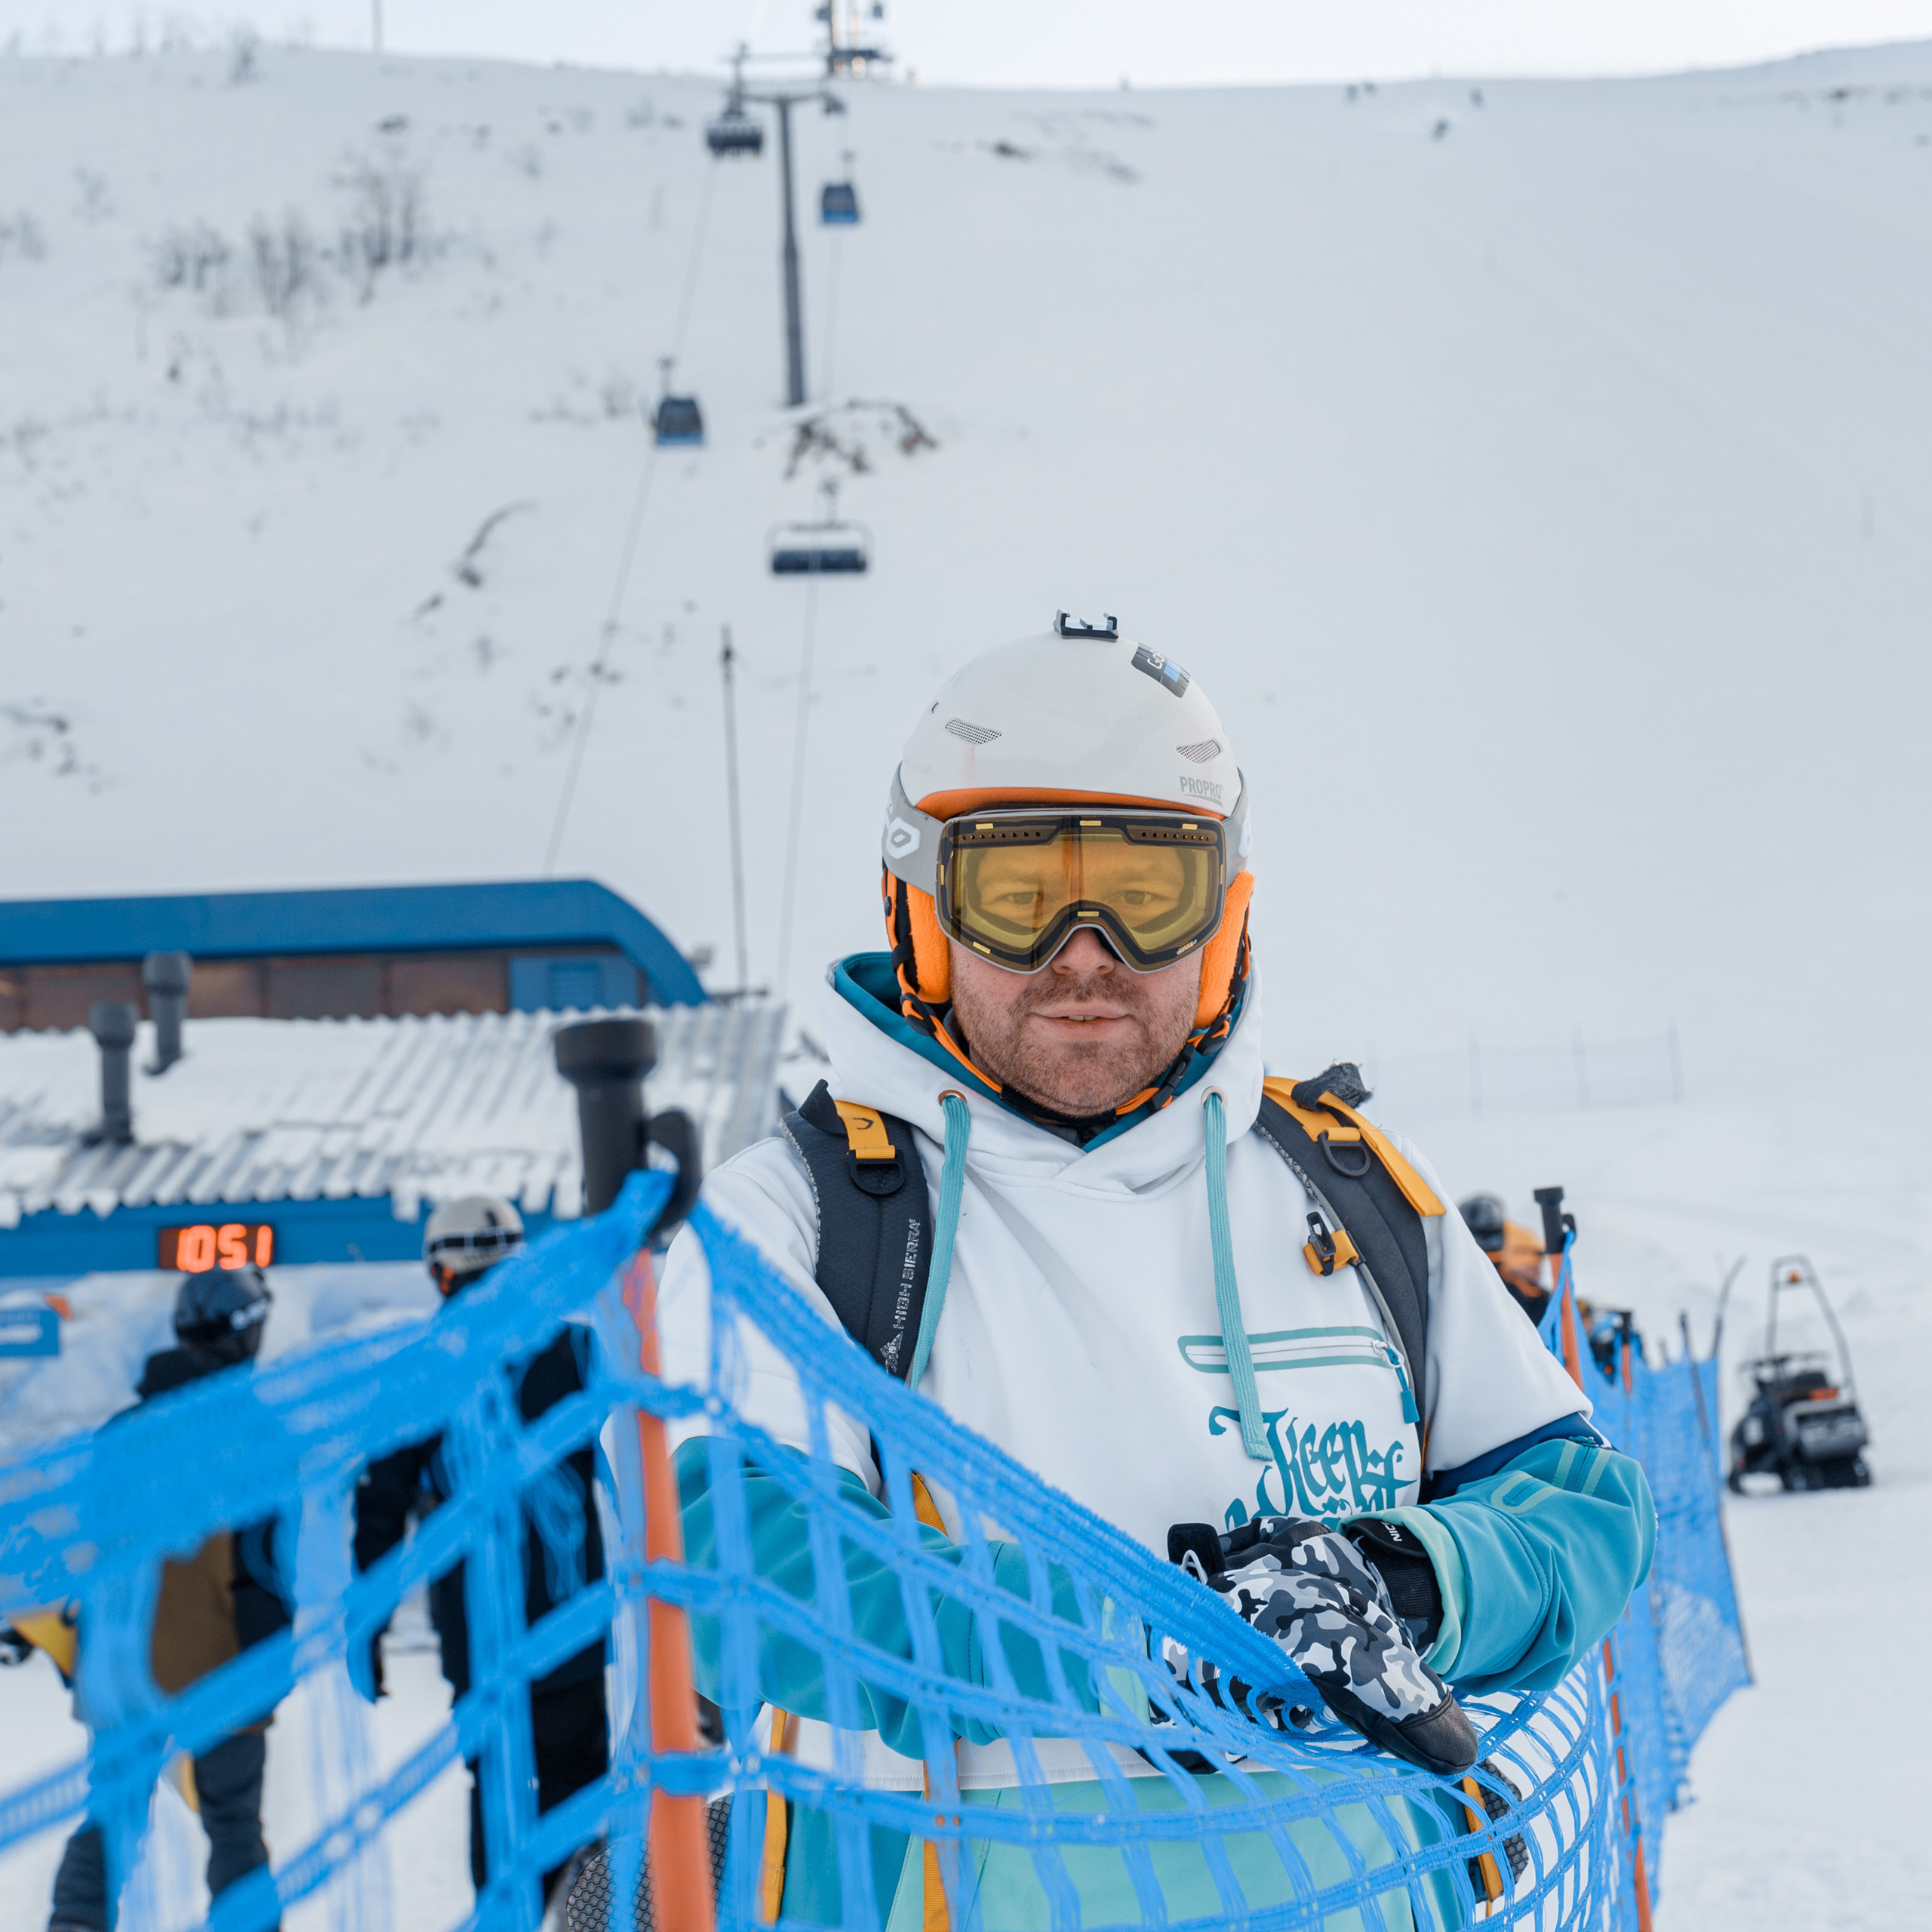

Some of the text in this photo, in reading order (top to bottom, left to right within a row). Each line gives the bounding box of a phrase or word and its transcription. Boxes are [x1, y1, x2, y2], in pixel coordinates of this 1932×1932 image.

[1146, 648, 1164, 669] Go
[1179, 776, 1222, 800] PROPRO
[893, 1222, 921, 1330] HIGH SIERRA
